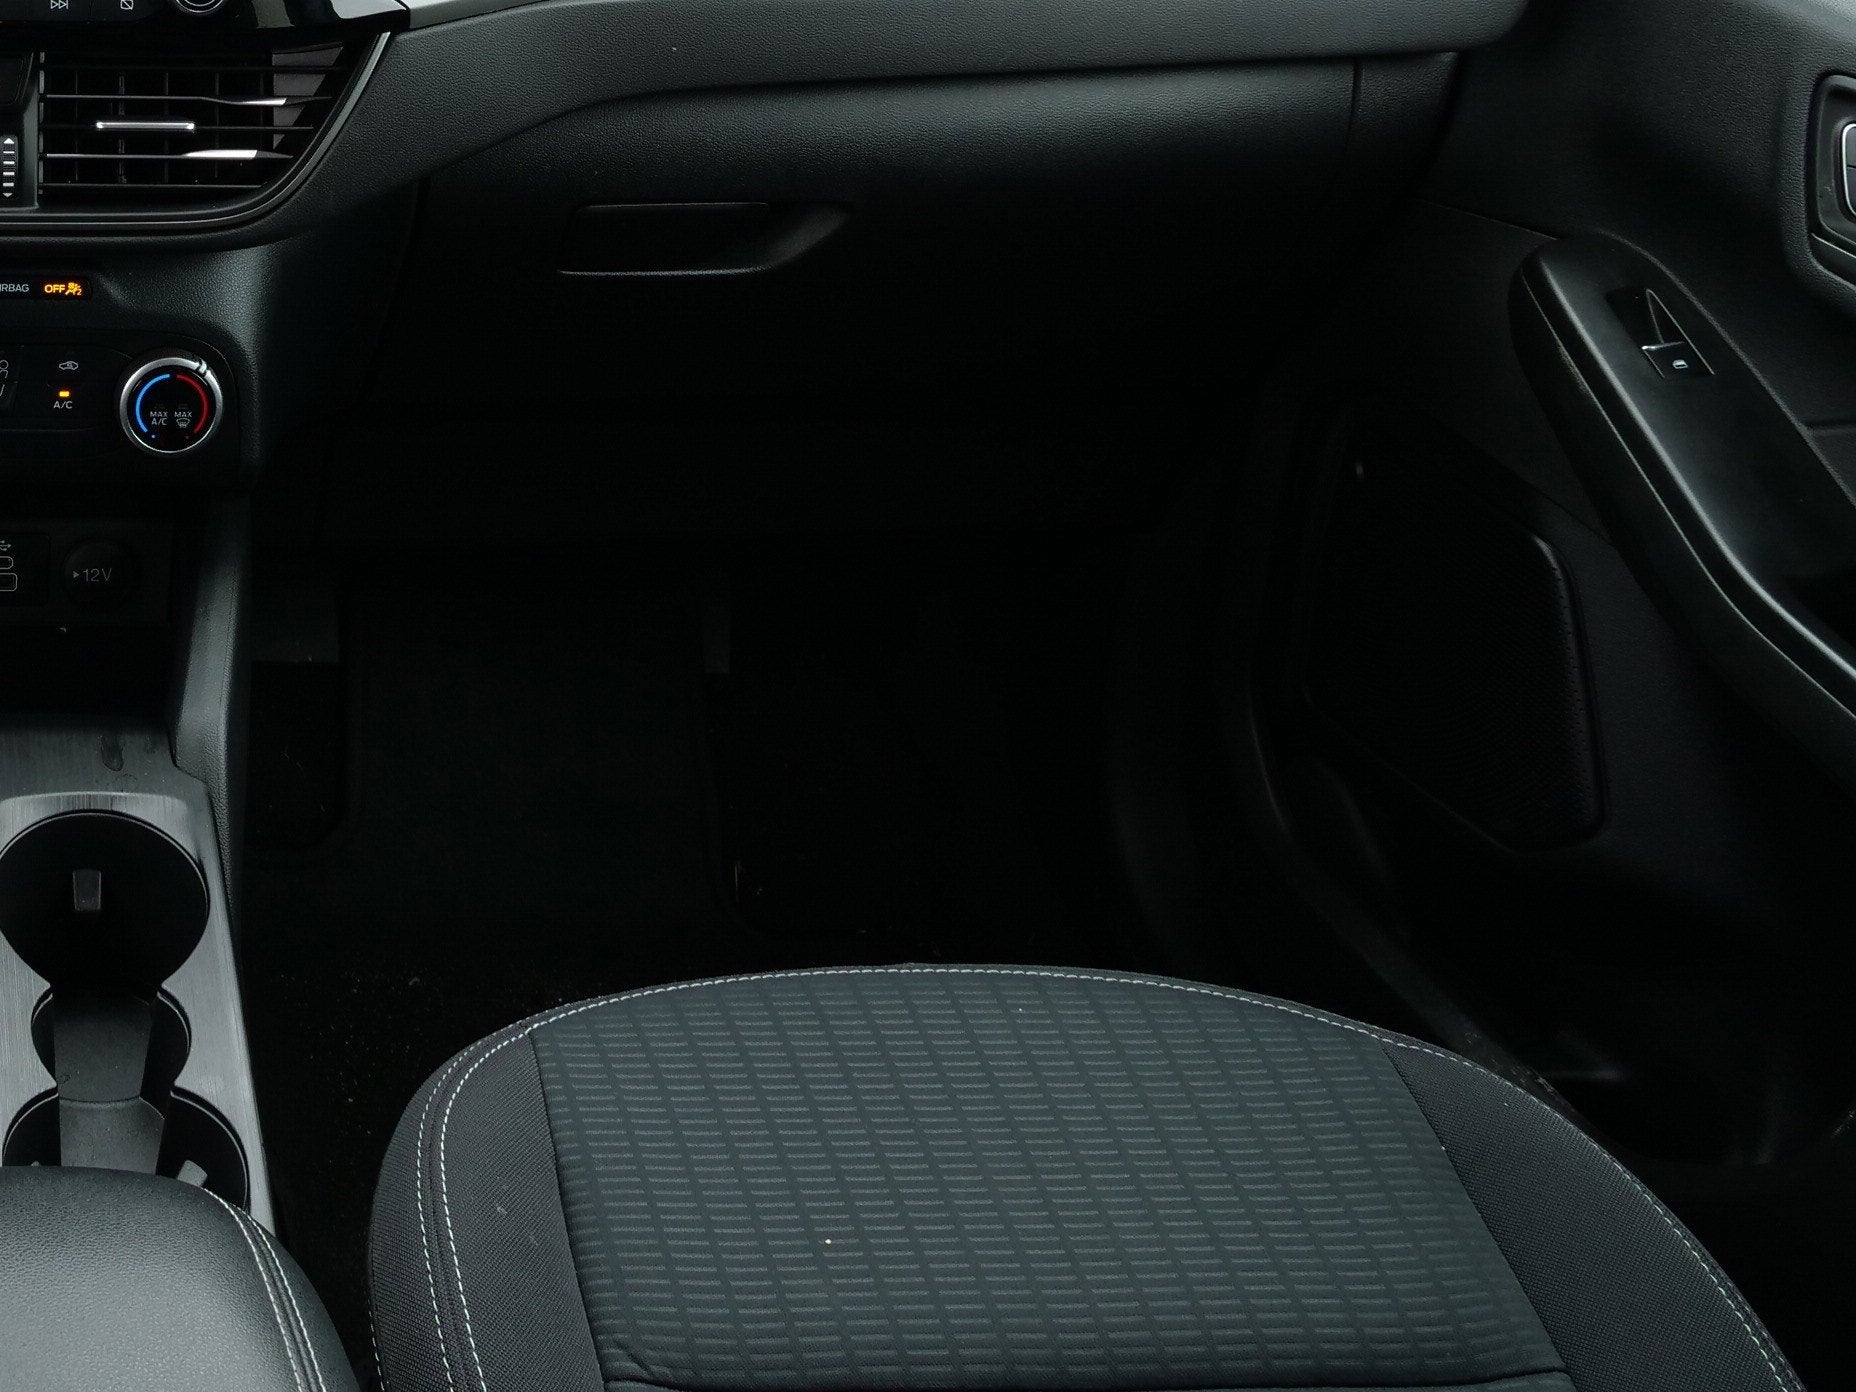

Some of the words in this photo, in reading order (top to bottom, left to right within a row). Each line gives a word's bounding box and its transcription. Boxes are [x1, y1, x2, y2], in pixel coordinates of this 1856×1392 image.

[44, 284, 66, 294] OFF
[53, 400, 73, 409] A/C
[151, 418, 167, 426] A/C
[83, 568, 112, 582] 12V
